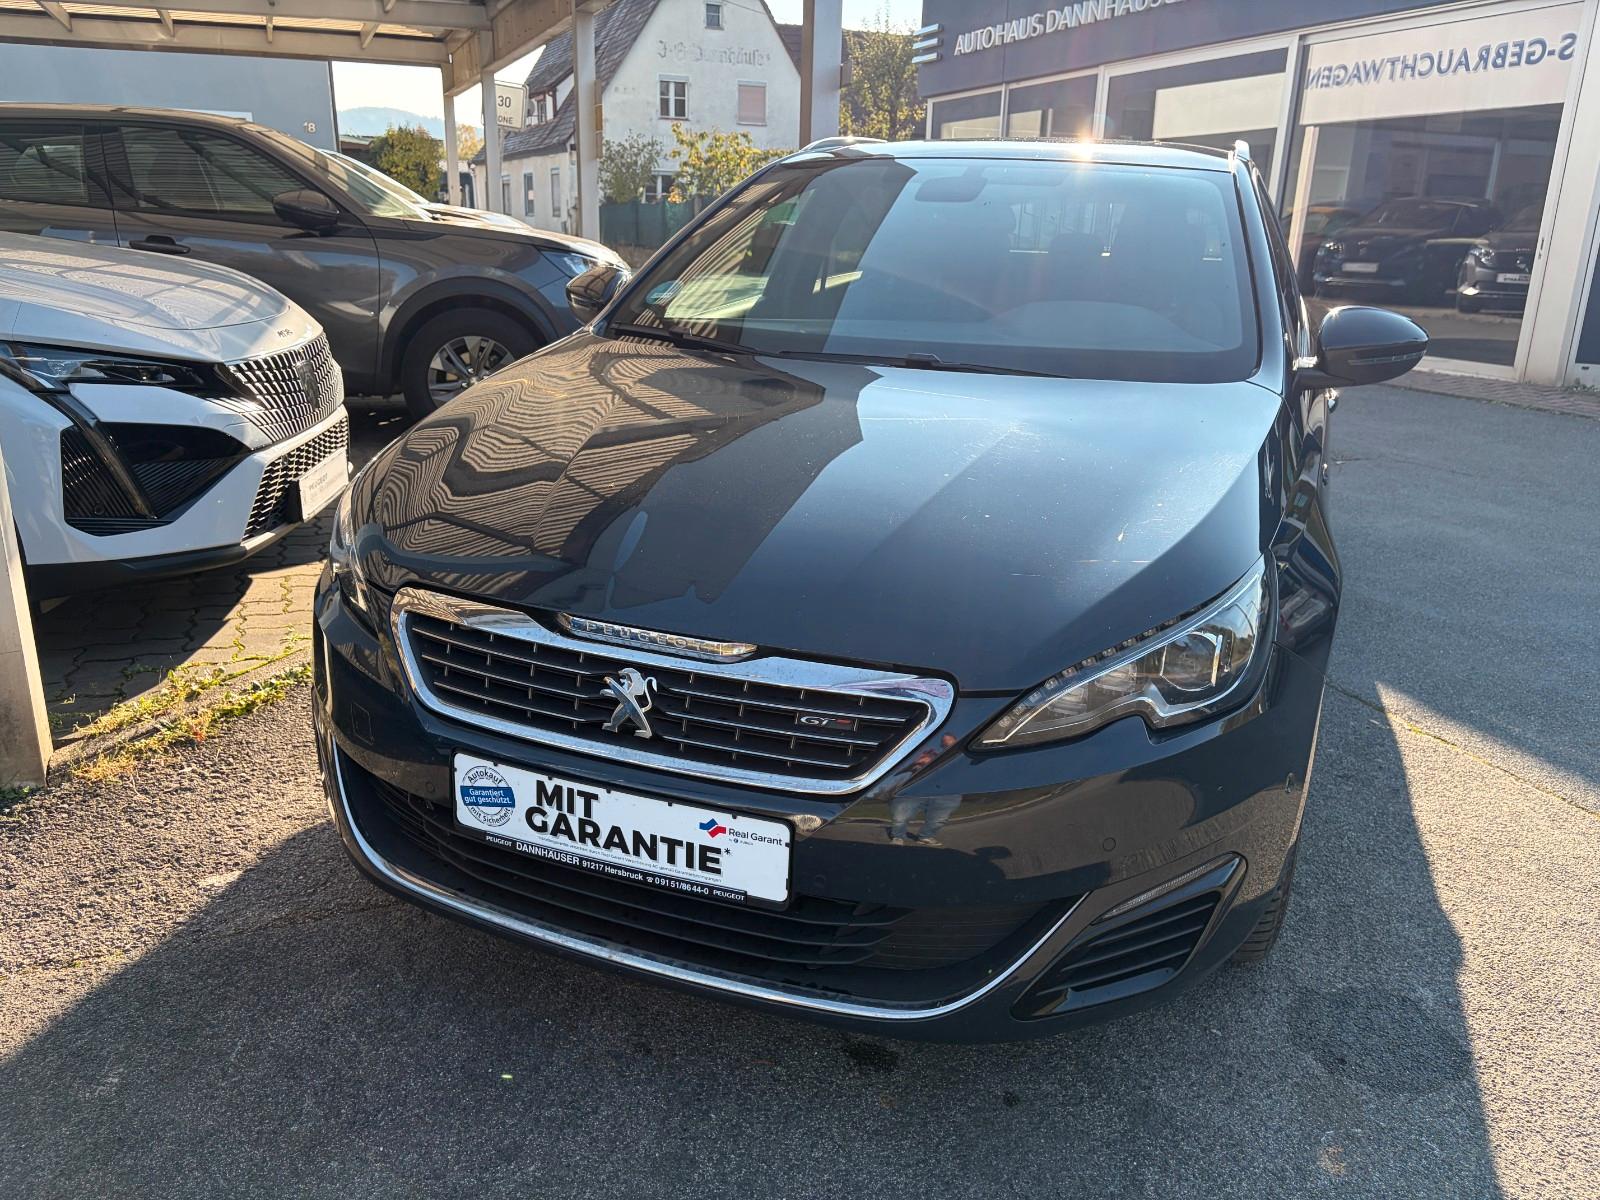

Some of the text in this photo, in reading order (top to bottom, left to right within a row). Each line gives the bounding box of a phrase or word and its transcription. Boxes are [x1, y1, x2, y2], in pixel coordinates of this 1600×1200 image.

[954, 13, 1044, 55] AUTOHAUS
[497, 95, 512, 108] 30
[497, 115, 513, 125] ONE
[585, 621, 707, 651] PEUGEOT
[467, 768, 504, 785] Autokauf
[464, 796, 477, 804] gut
[469, 788, 505, 797] Garantiert
[535, 779, 599, 819] MIT
[470, 806, 511, 824] mit Sicherheit
[728, 828, 749, 839] Real
[750, 832, 783, 846] Garant
[486, 835, 512, 847] PEUGEOT
[582, 860, 604, 871] 91217
[604, 865, 643, 881] Hersbruck
[713, 889, 745, 901] PEUGEOT
